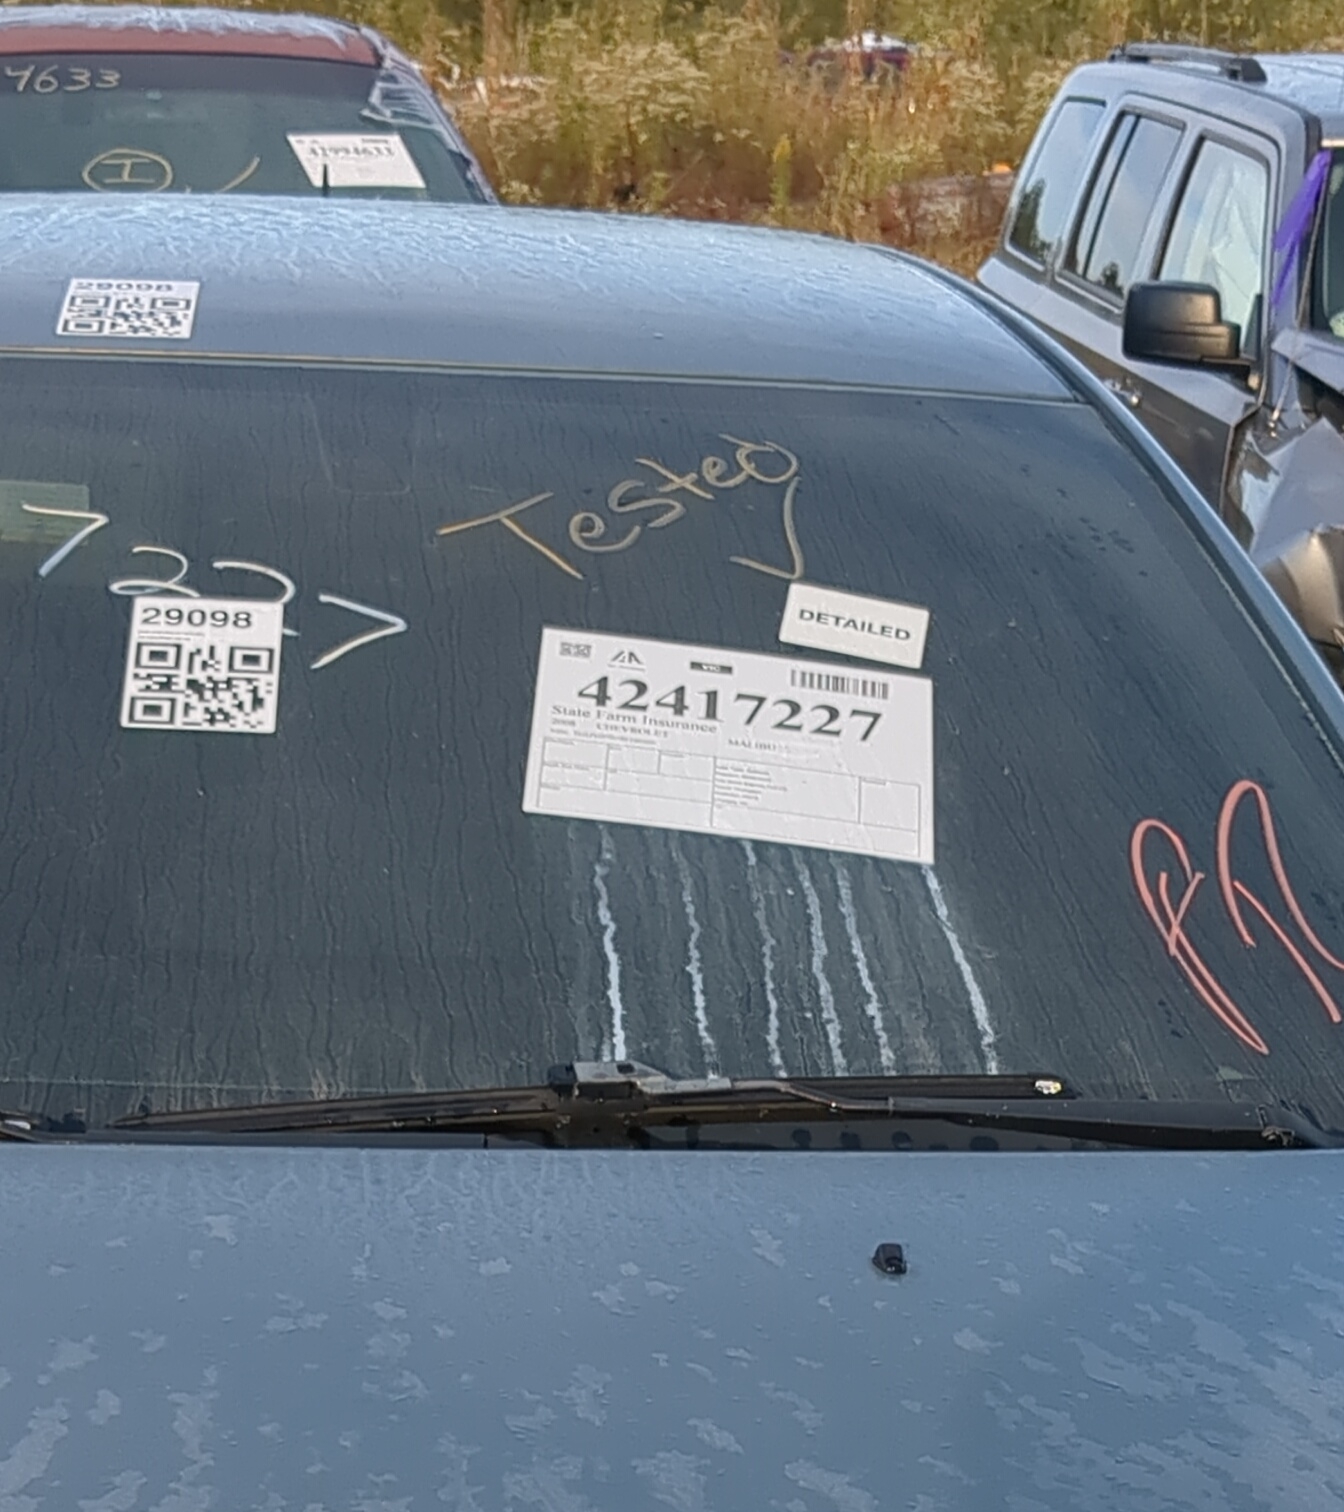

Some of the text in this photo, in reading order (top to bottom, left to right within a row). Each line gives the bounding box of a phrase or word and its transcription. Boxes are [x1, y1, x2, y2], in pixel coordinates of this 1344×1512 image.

[140, 607, 252, 629] 29098
[797, 607, 912, 643] DETAILED
[551, 705, 718, 734] State Farm Insurance
[577, 674, 883, 743] 42417227
